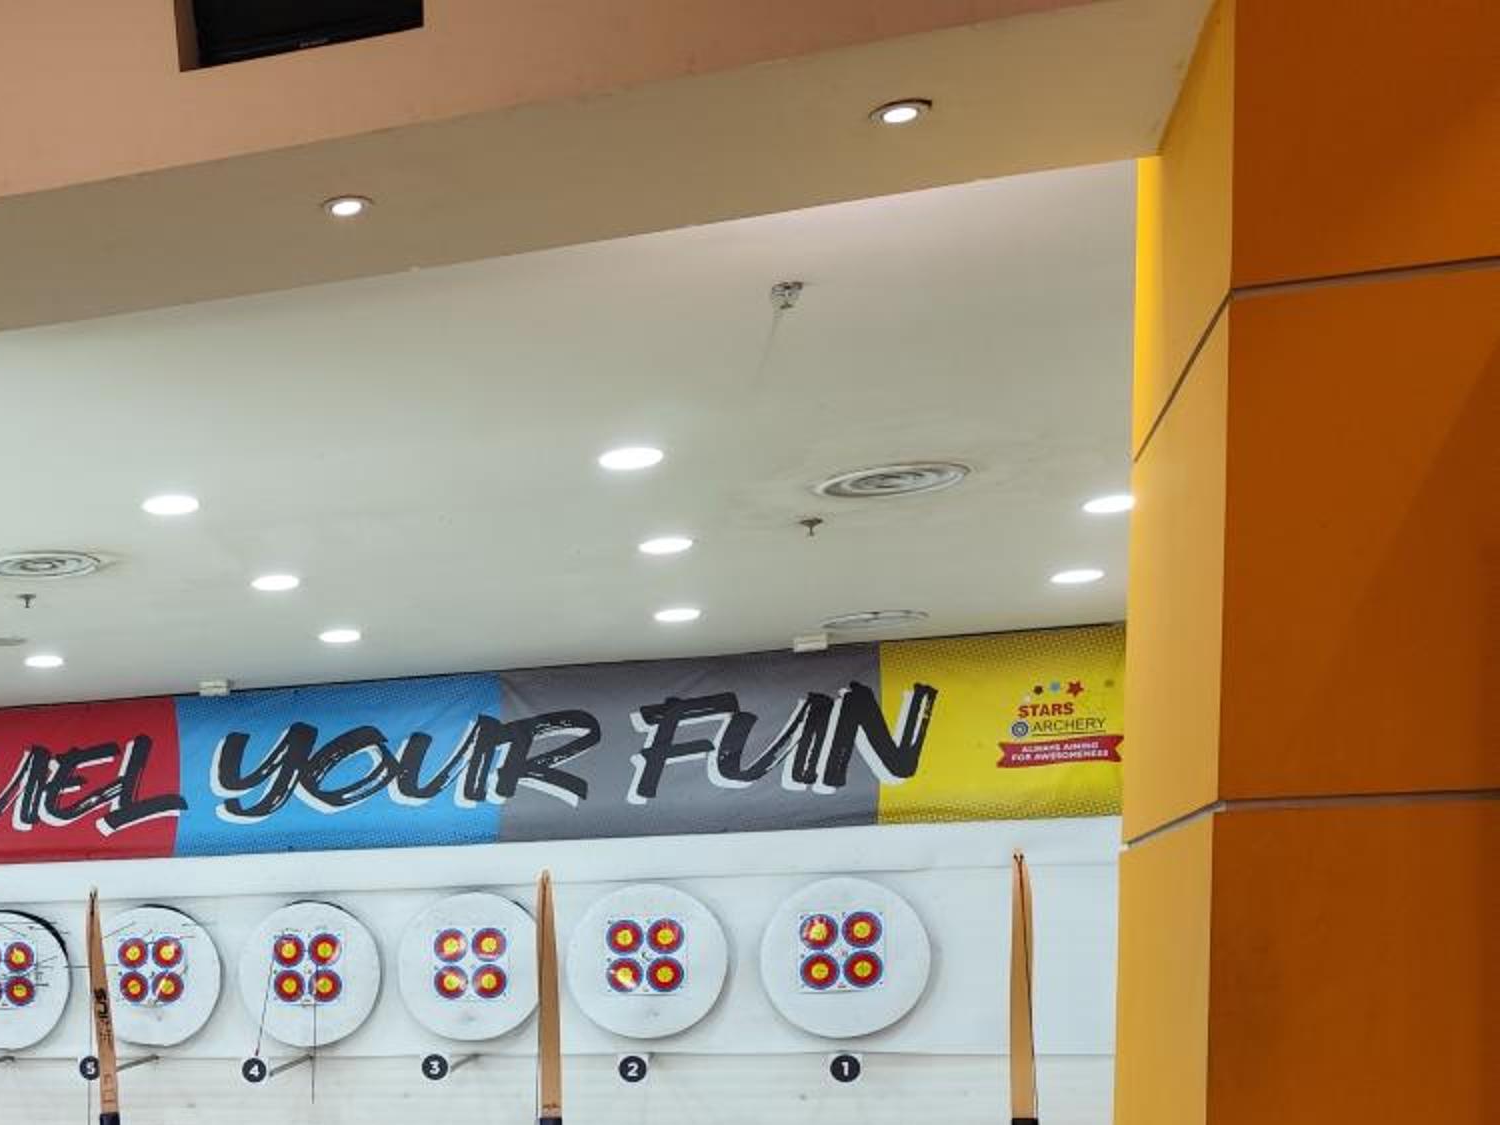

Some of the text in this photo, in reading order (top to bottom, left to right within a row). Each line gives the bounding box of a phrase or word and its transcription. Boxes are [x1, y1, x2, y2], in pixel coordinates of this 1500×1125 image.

[1018, 702, 1075, 718] STARS
[1031, 718, 1107, 732] ARCHERY
[211, 708, 601, 824] YOUR
[628, 682, 938, 804] FUN
